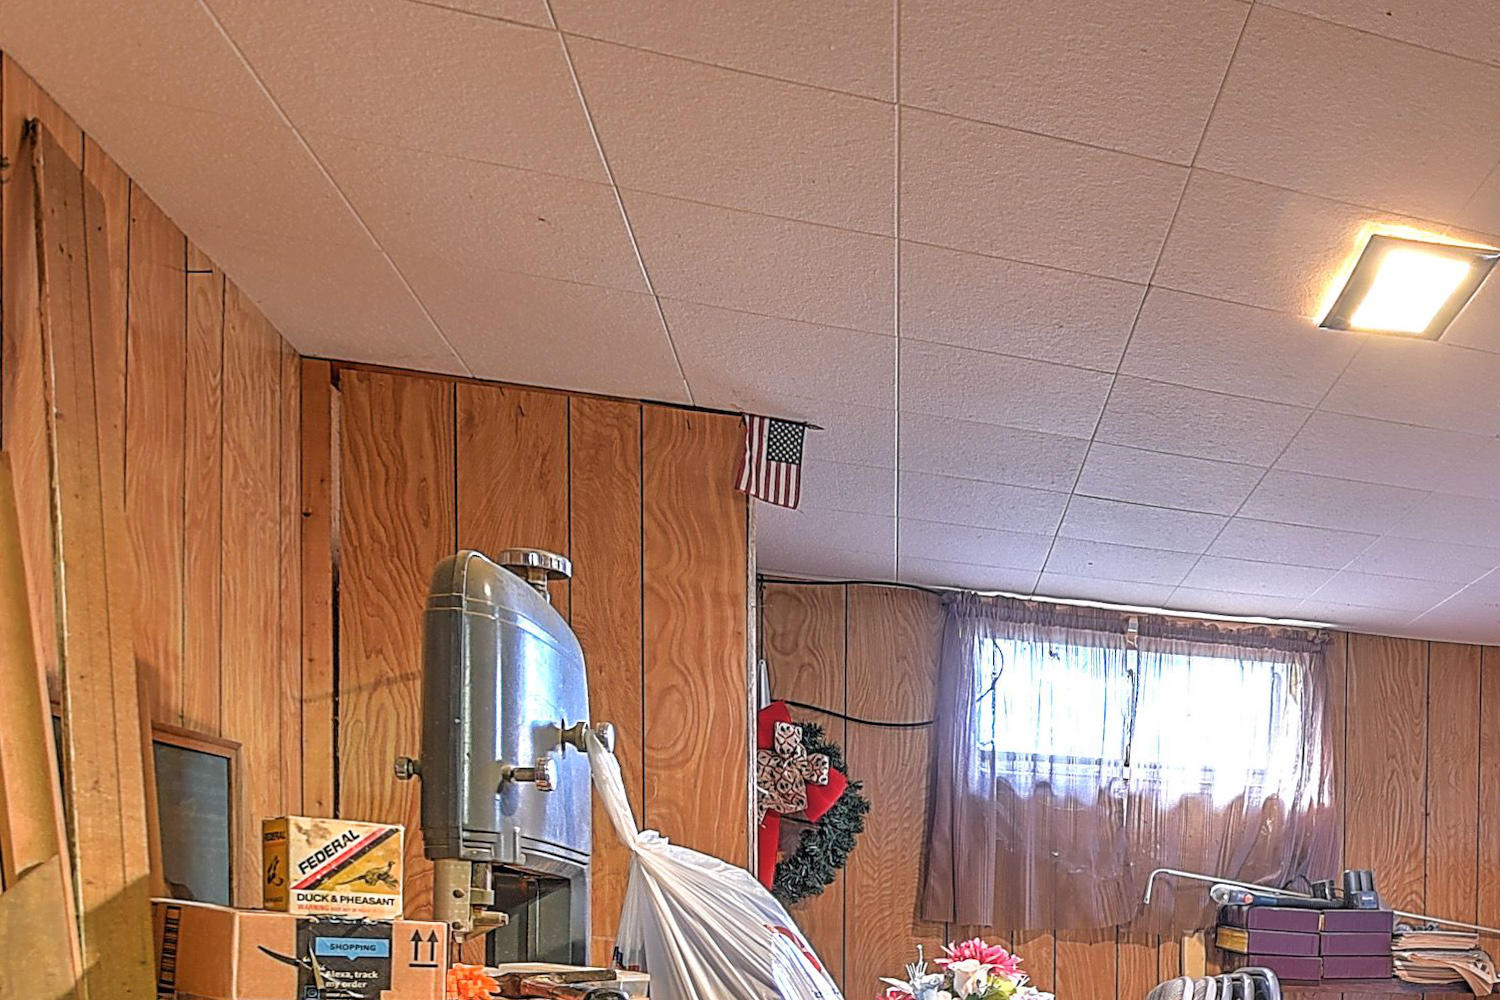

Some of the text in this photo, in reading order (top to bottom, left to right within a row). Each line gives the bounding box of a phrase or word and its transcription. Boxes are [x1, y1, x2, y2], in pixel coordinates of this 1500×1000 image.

[298, 829, 360, 875] FEDERAL
[296, 893, 395, 906] DUCK & PHEASANT
[329, 943, 377, 951] SHOPPING
[354, 970, 378, 979] track
[325, 981, 340, 989] my
